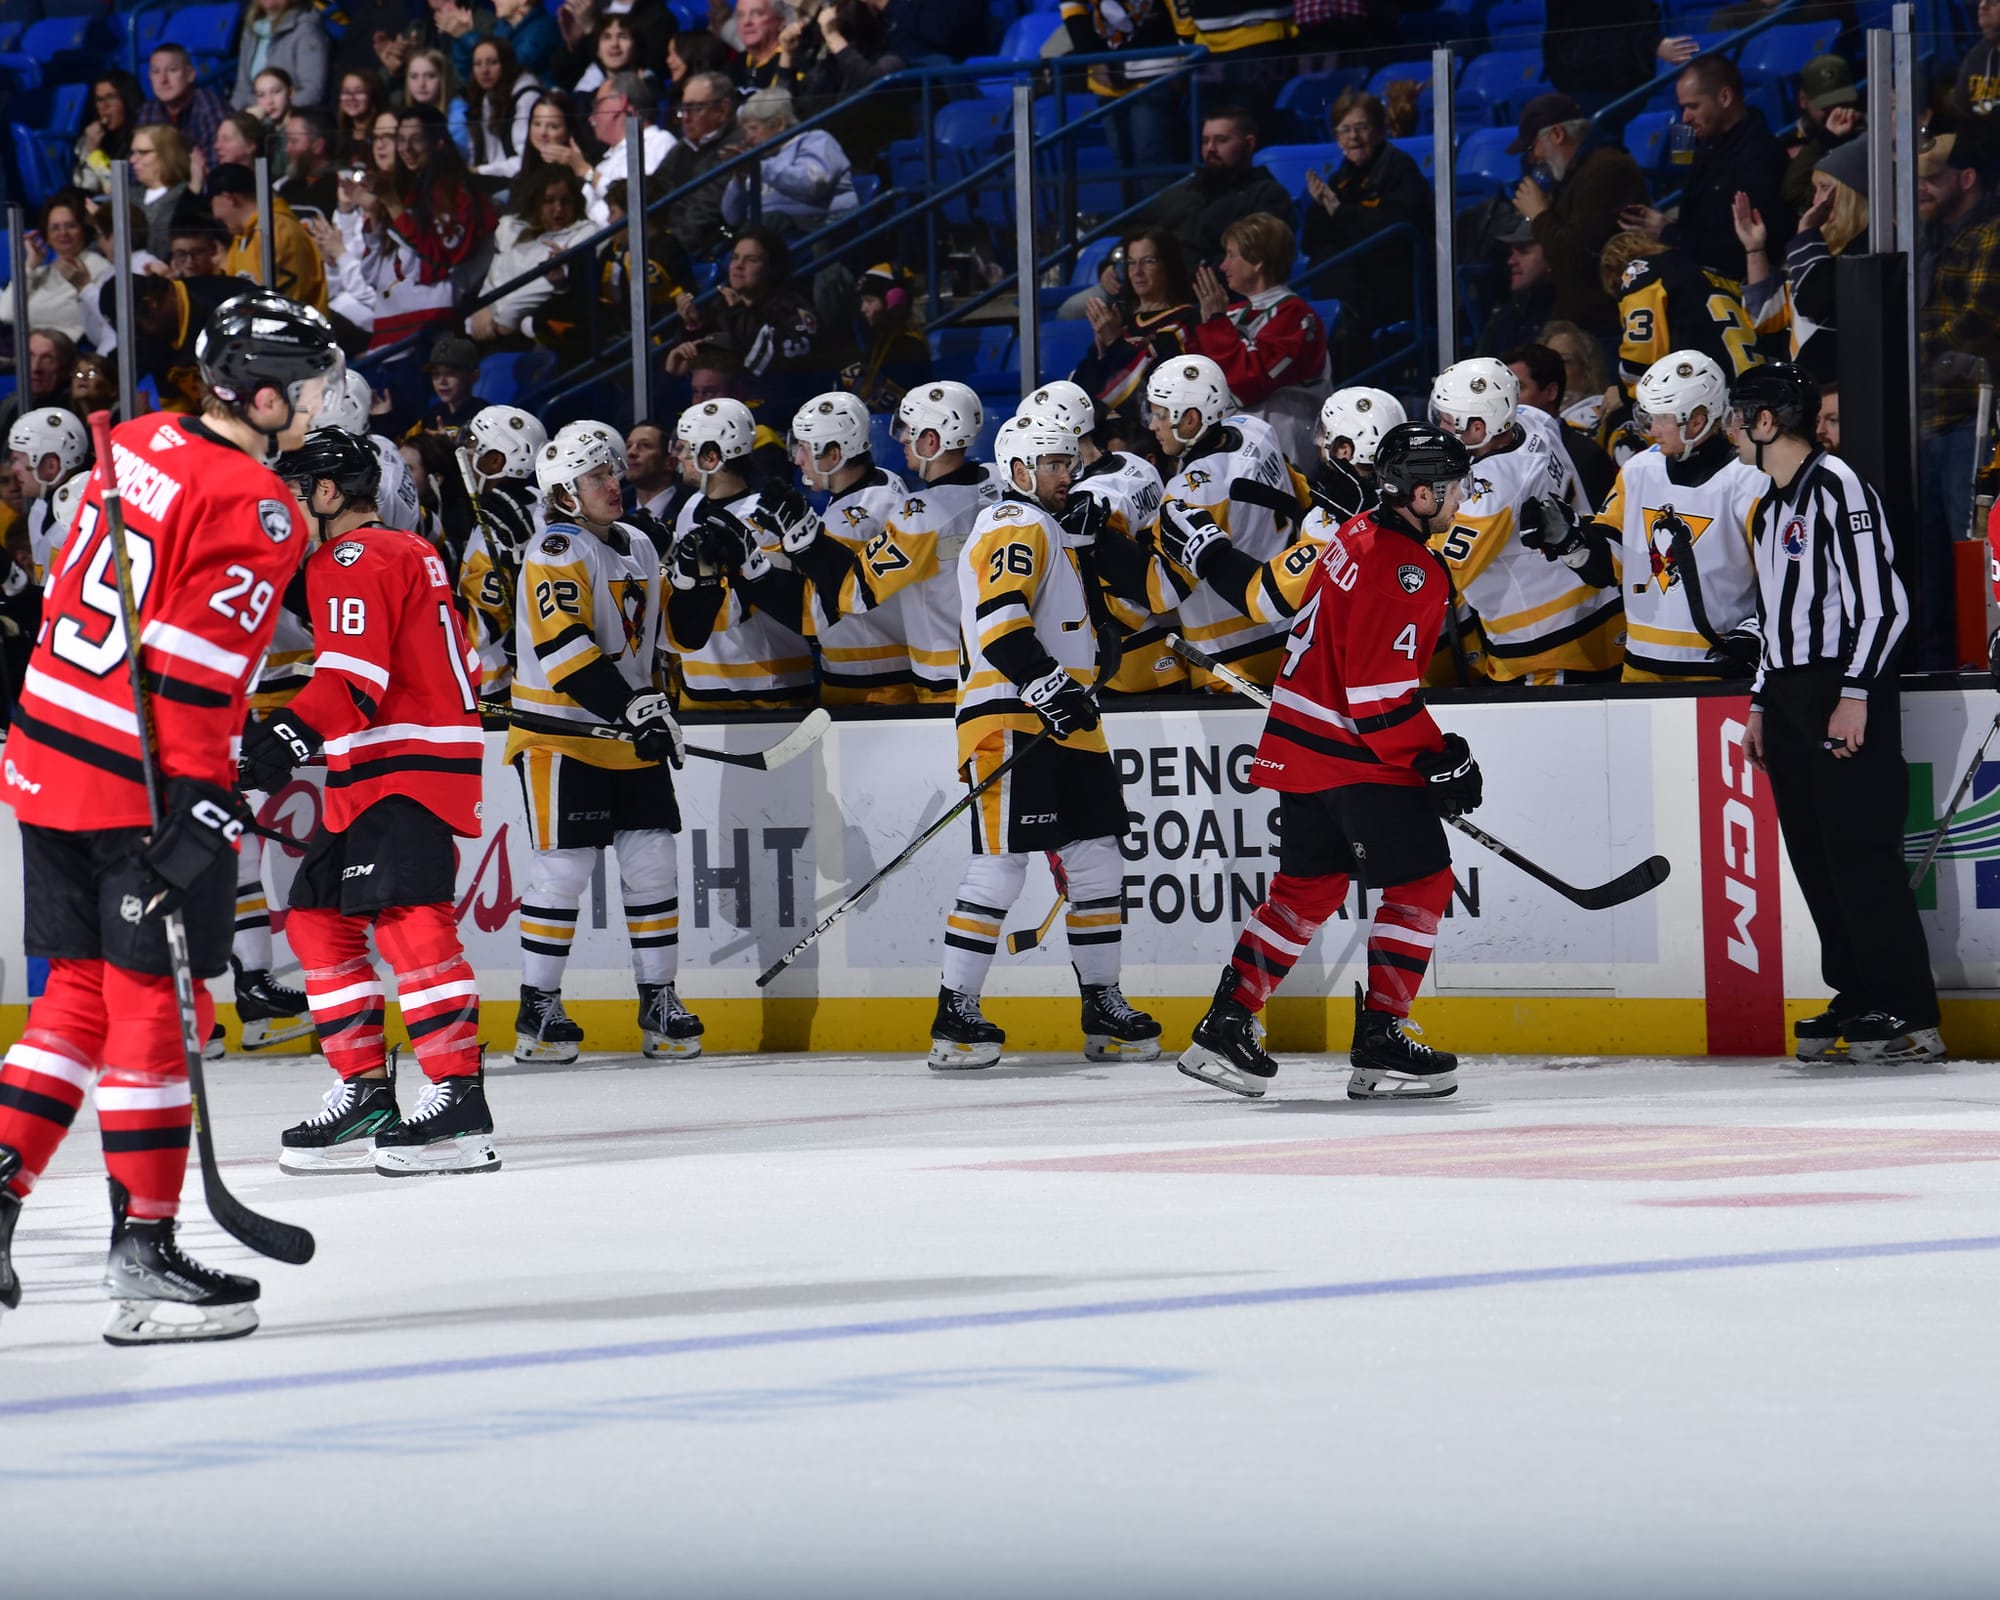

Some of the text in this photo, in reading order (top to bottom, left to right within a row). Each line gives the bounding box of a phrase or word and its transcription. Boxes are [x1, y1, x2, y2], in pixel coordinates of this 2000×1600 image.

[1848, 511, 1873, 533] 60
[988, 541, 1034, 584] 36
[1442, 524, 1481, 563] 5
[208, 564, 275, 634] 29
[326, 596, 367, 637] 18
[535, 579, 581, 622] 22
[1392, 622, 1418, 661] 4
[1030, 671, 1070, 703] CCM
[1430, 757, 1473, 783] CC
[191, 800, 245, 843] CC
[1719, 716, 1760, 974] CCM
[121, 1256, 197, 1301] VAPOR
